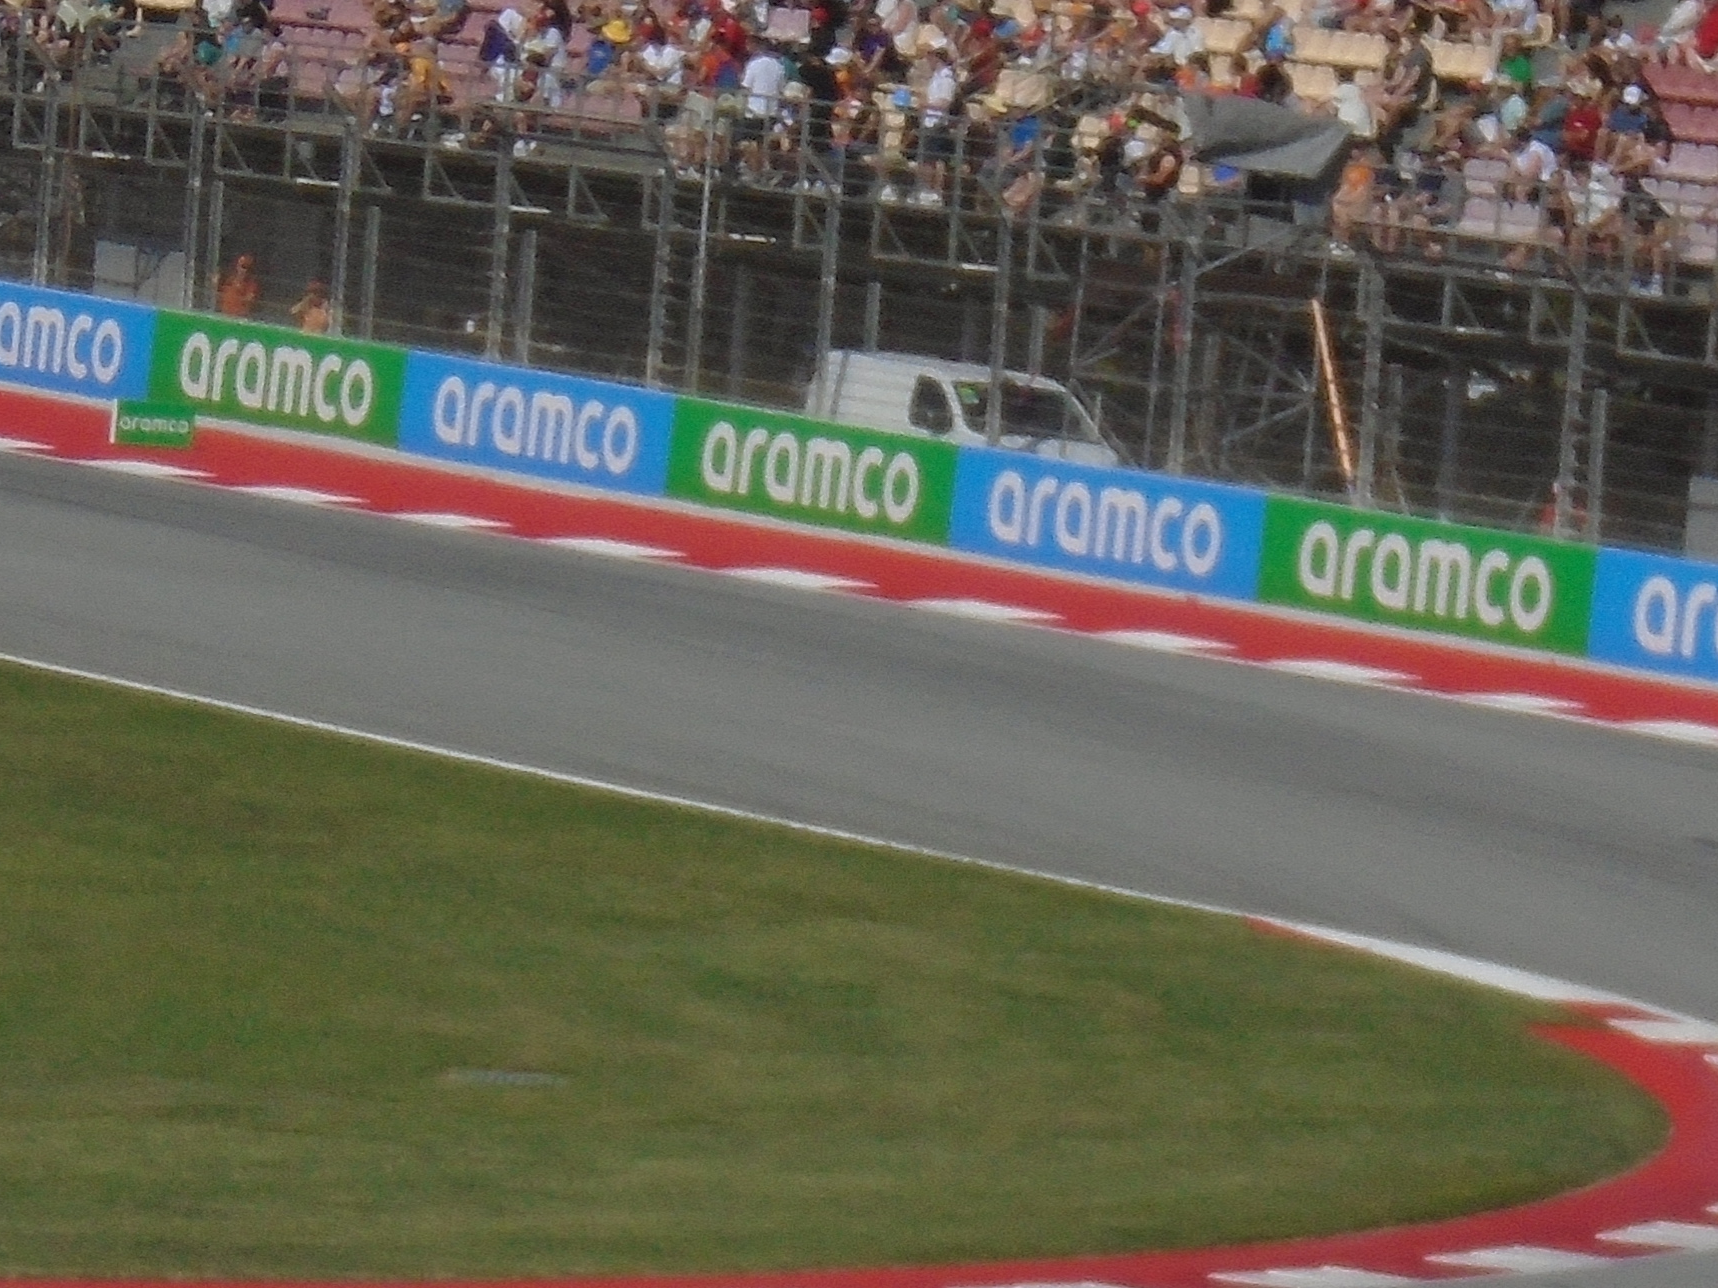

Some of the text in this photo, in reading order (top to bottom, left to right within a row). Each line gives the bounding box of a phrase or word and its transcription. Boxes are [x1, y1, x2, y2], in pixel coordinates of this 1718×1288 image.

[119, 413, 190, 437] aramco
[179, 331, 374, 427] aramco
[433, 375, 638, 475] aramco
[701, 420, 920, 525] aramco
[988, 470, 1223, 577] aramco
[1298, 520, 1552, 634] aramco
